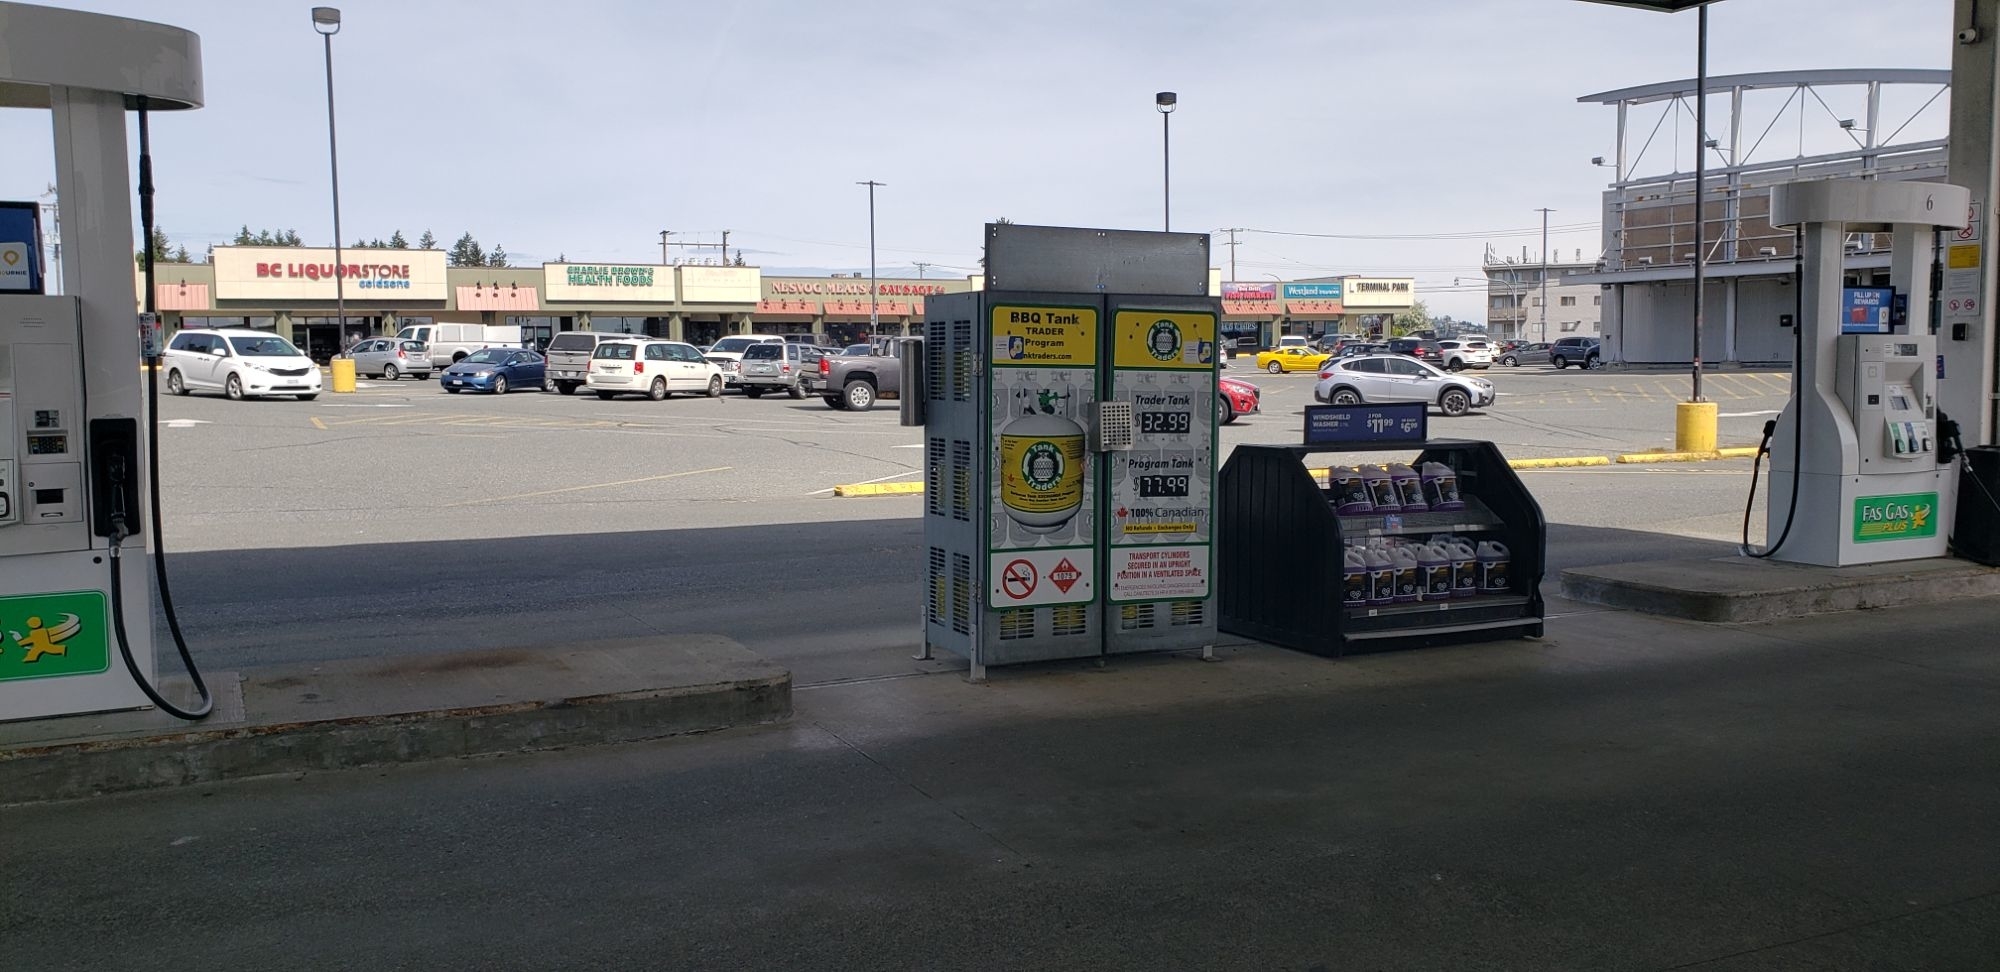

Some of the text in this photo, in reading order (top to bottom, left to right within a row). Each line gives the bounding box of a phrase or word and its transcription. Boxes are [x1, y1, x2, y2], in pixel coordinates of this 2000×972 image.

[1926, 194, 1933, 210] 6
[256, 263, 282, 278] BC
[567, 266, 654, 275] CHARLIE BROWN'S
[359, 279, 410, 289] coldzone
[568, 275, 653, 287] HEALTH FOODS
[772, 282, 822, 294] NESVOG
[826, 283, 866, 294] MEATS
[879, 285, 933, 296] SAUSAGE
[1288, 286, 1318, 295] Westland
[1356, 283, 1390, 292] TERMINAL
[1392, 283, 1409, 292] PARK
[1011, 312, 1079, 324] BBQ Tank
[1026, 327, 1064, 336] TRADER
[1025, 339, 1064, 348] Program
[1024, 352, 1072, 360] nktraders.com
[1152, 349, 1179, 360] Traders
[1136, 395, 1190, 405] Trader Tank
[1032, 444, 1054, 453] Tank
[1129, 458, 1194, 472] Program Tank
[1027, 476, 1061, 490] Traders
[1131, 507, 1204, 518] 100% Canadian
[1863, 503, 1908, 521] FAS GAS
[1882, 522, 1908, 531] PLUS
[1129, 551, 1190, 560] TRANSPORT CYLINDERS
[1128, 562, 1151, 570] SECURED
[1169, 560, 1190, 568] UPRIGHT
[1154, 570, 1184, 578] VENTILATED
[1185, 569, 1202, 577] SPACE
